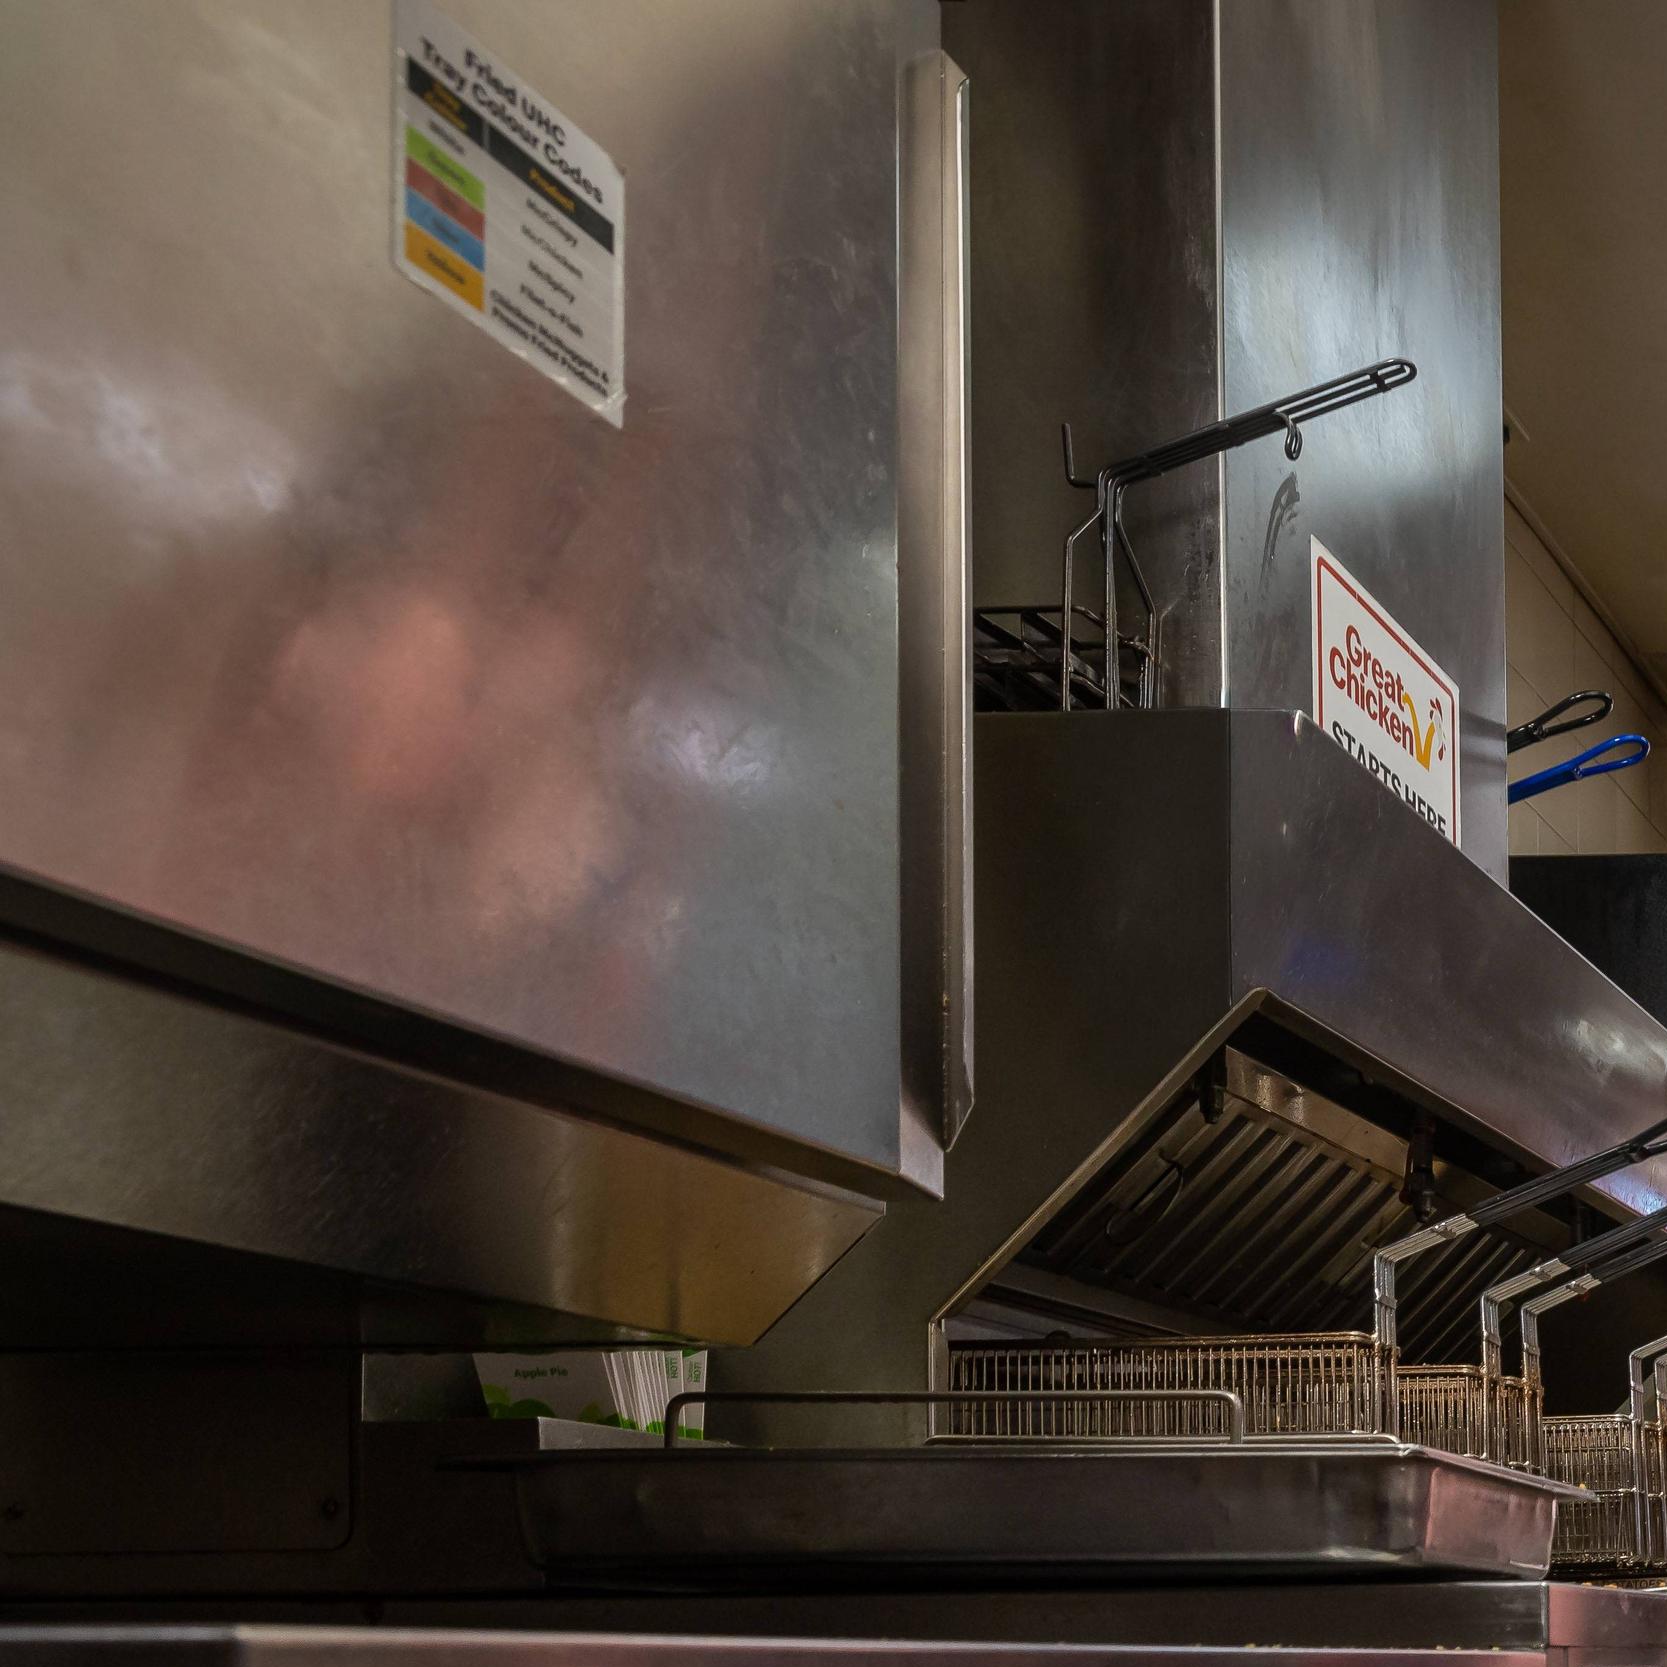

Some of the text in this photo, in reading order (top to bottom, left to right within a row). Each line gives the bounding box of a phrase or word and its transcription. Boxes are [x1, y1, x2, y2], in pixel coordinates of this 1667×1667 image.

[419, 34, 603, 204] Tray Colour Codes
[464, 48, 566, 147] Fried UHC
[1330, 646, 1414, 757] Chicken
[1346, 625, 1404, 713] Great
[514, 1366, 568, 1379] Apple Pie
